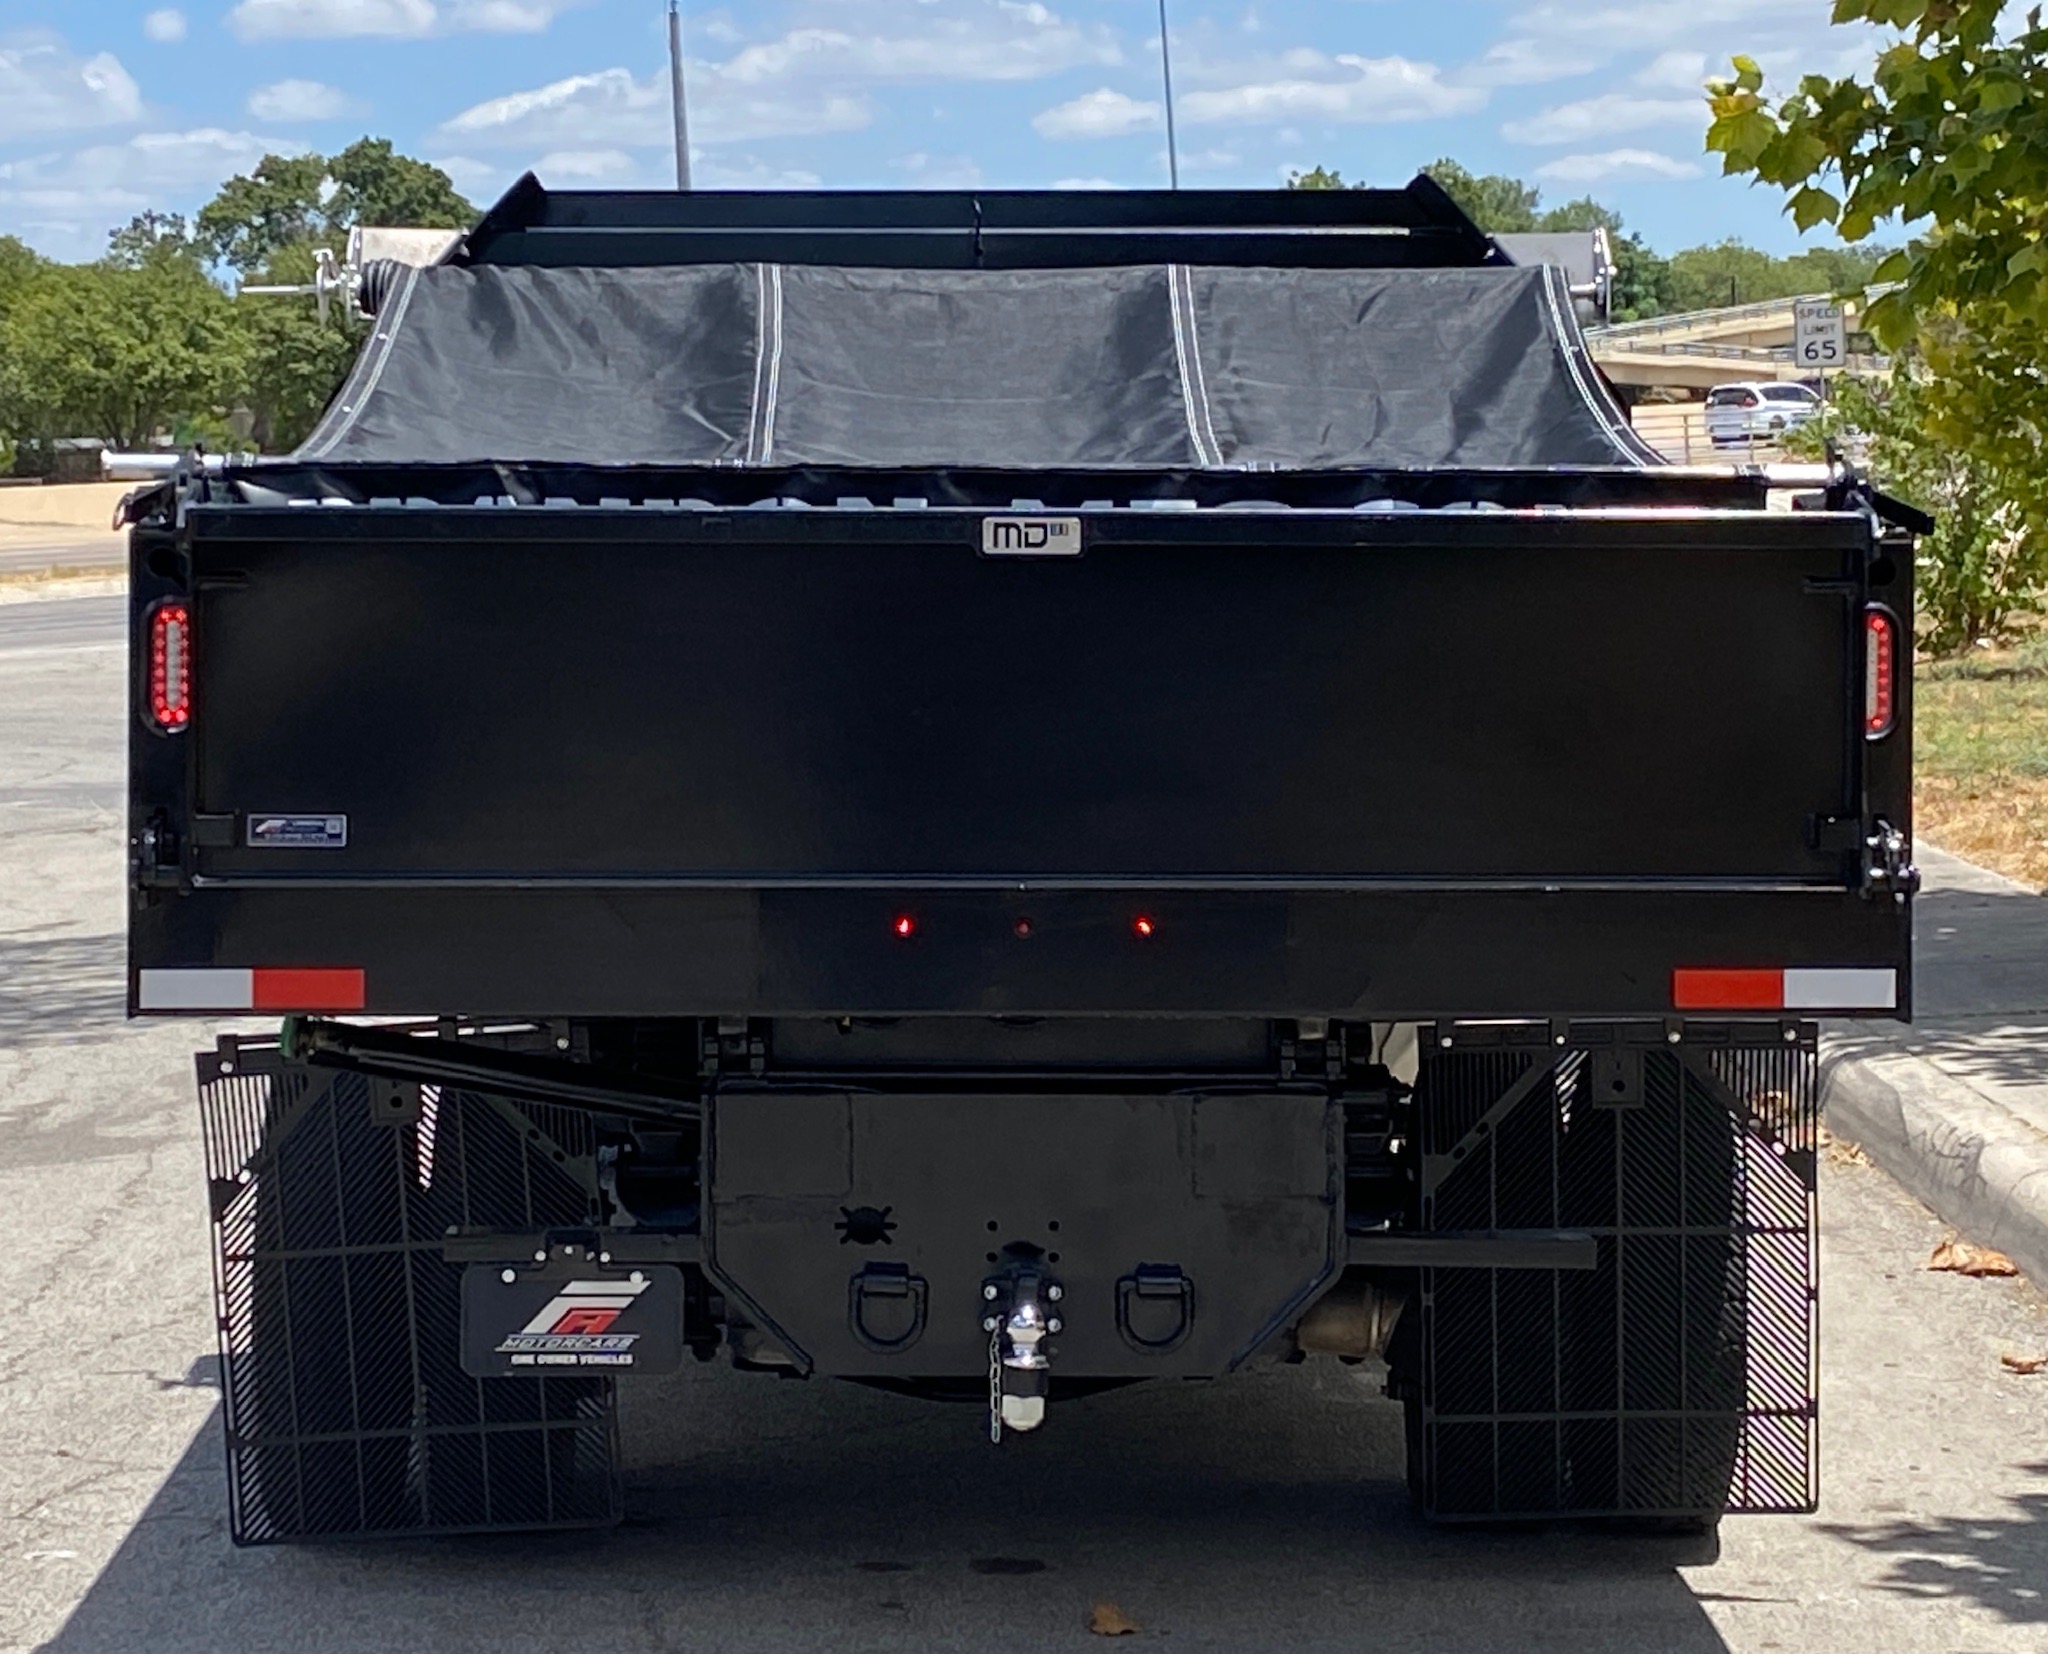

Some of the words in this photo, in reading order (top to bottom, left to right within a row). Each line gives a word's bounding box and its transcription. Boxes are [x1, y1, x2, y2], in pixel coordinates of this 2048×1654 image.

[1798, 308, 1840, 319] SPEED
[1803, 324, 1836, 335] LIMIT
[1804, 340, 1837, 360] 65
[500, 1337, 635, 1349] MOTORCARS
